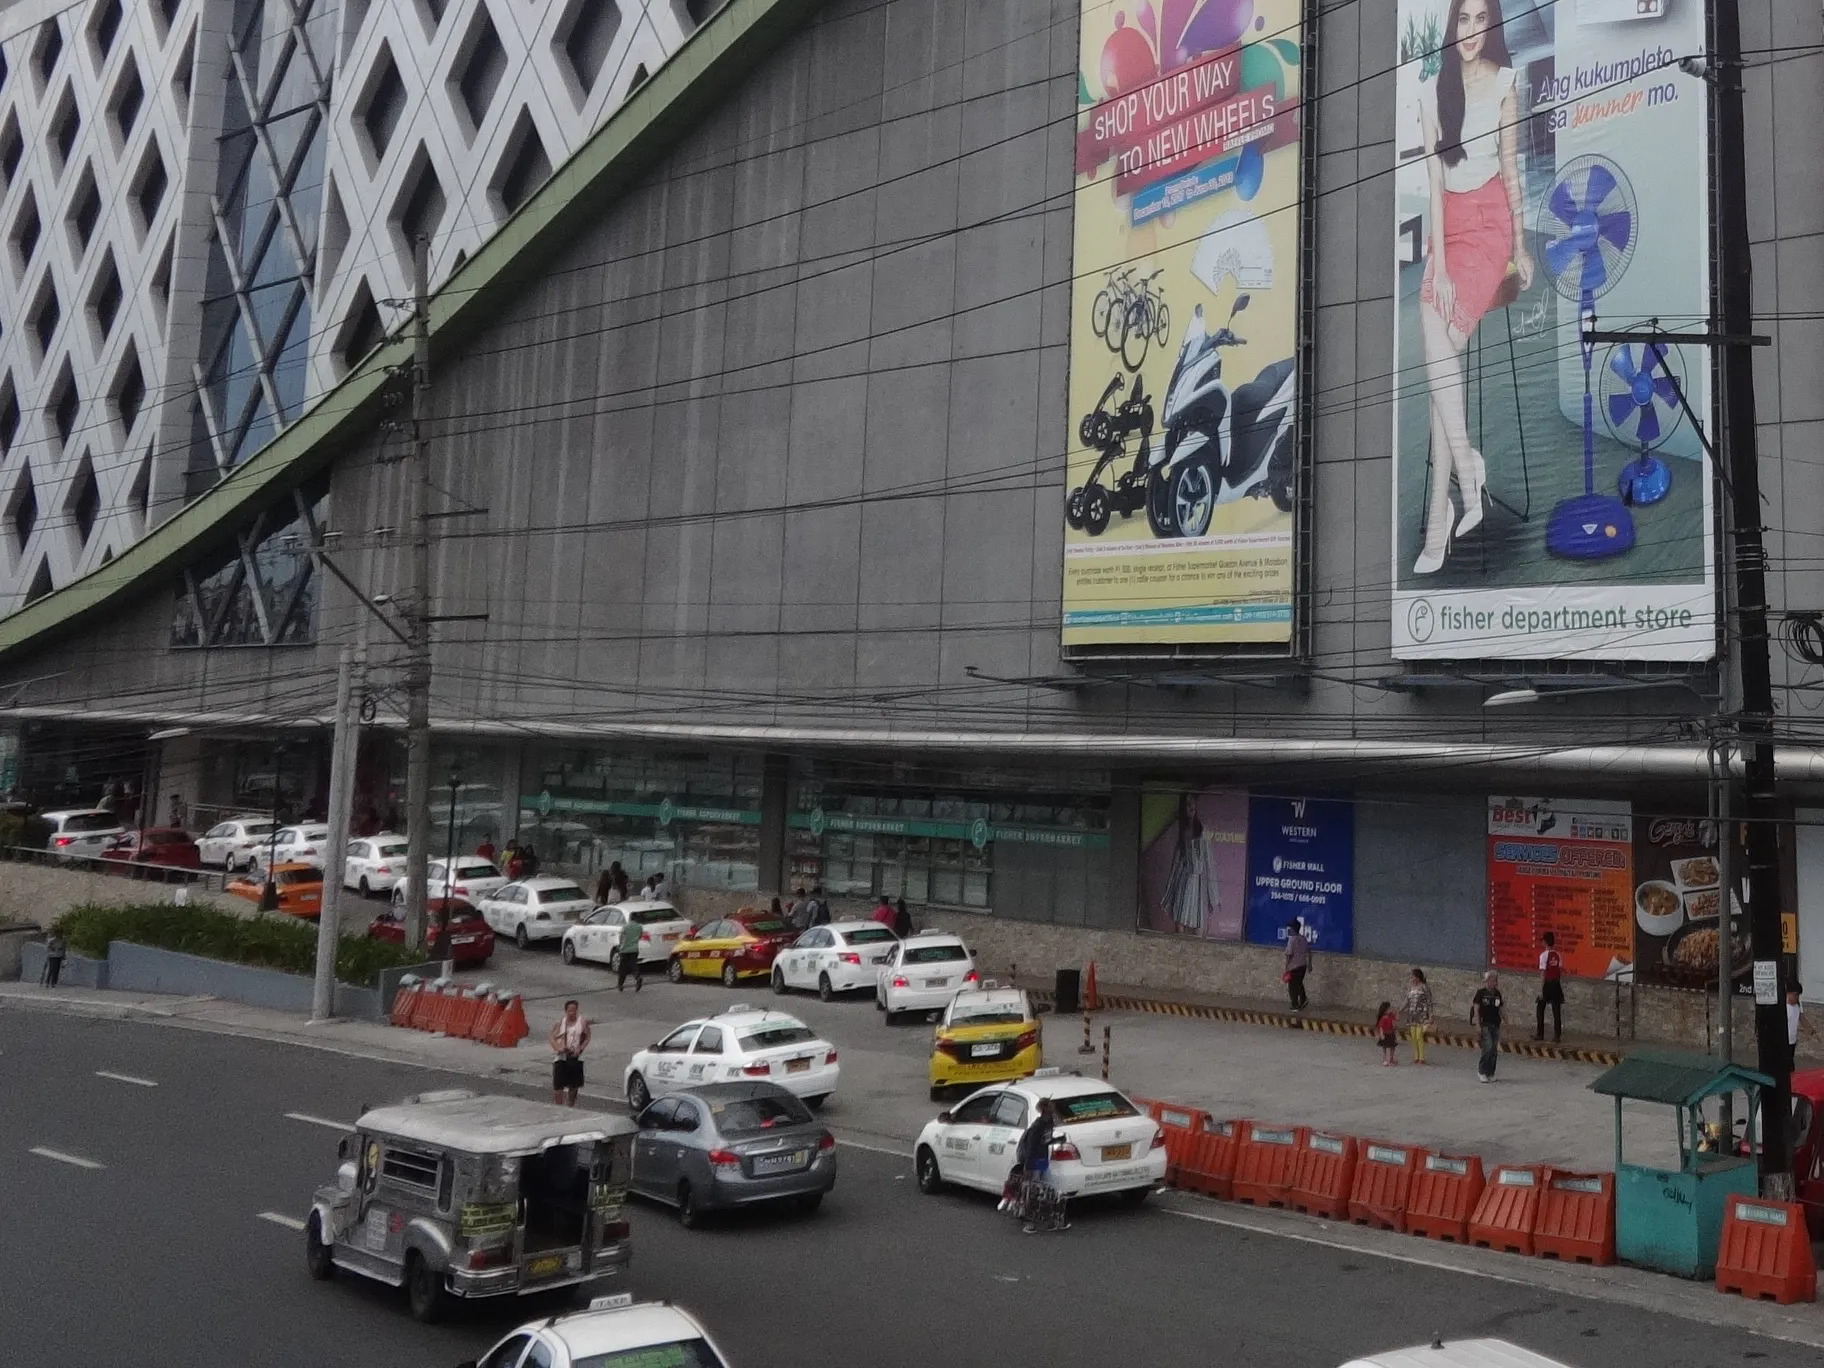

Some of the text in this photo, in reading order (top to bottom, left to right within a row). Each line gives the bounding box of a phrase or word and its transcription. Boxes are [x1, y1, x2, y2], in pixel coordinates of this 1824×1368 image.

[1537, 45, 1674, 103] Ang kukumpleto
[1095, 61, 1233, 140] SHOP YOUR WAY
[1549, 82, 1679, 131] sa summer mo.
[1119, 146, 1142, 177] TO
[1148, 121, 1190, 169] NEW
[1194, 95, 1275, 151] WHEELS
[1441, 604, 1692, 633] fisher department store
[1282, 826, 1317, 837] WESTERN
[1256, 877, 1342, 893] UPPER GROUND FLOOR
[1283, 862, 1306, 870] FISHER
